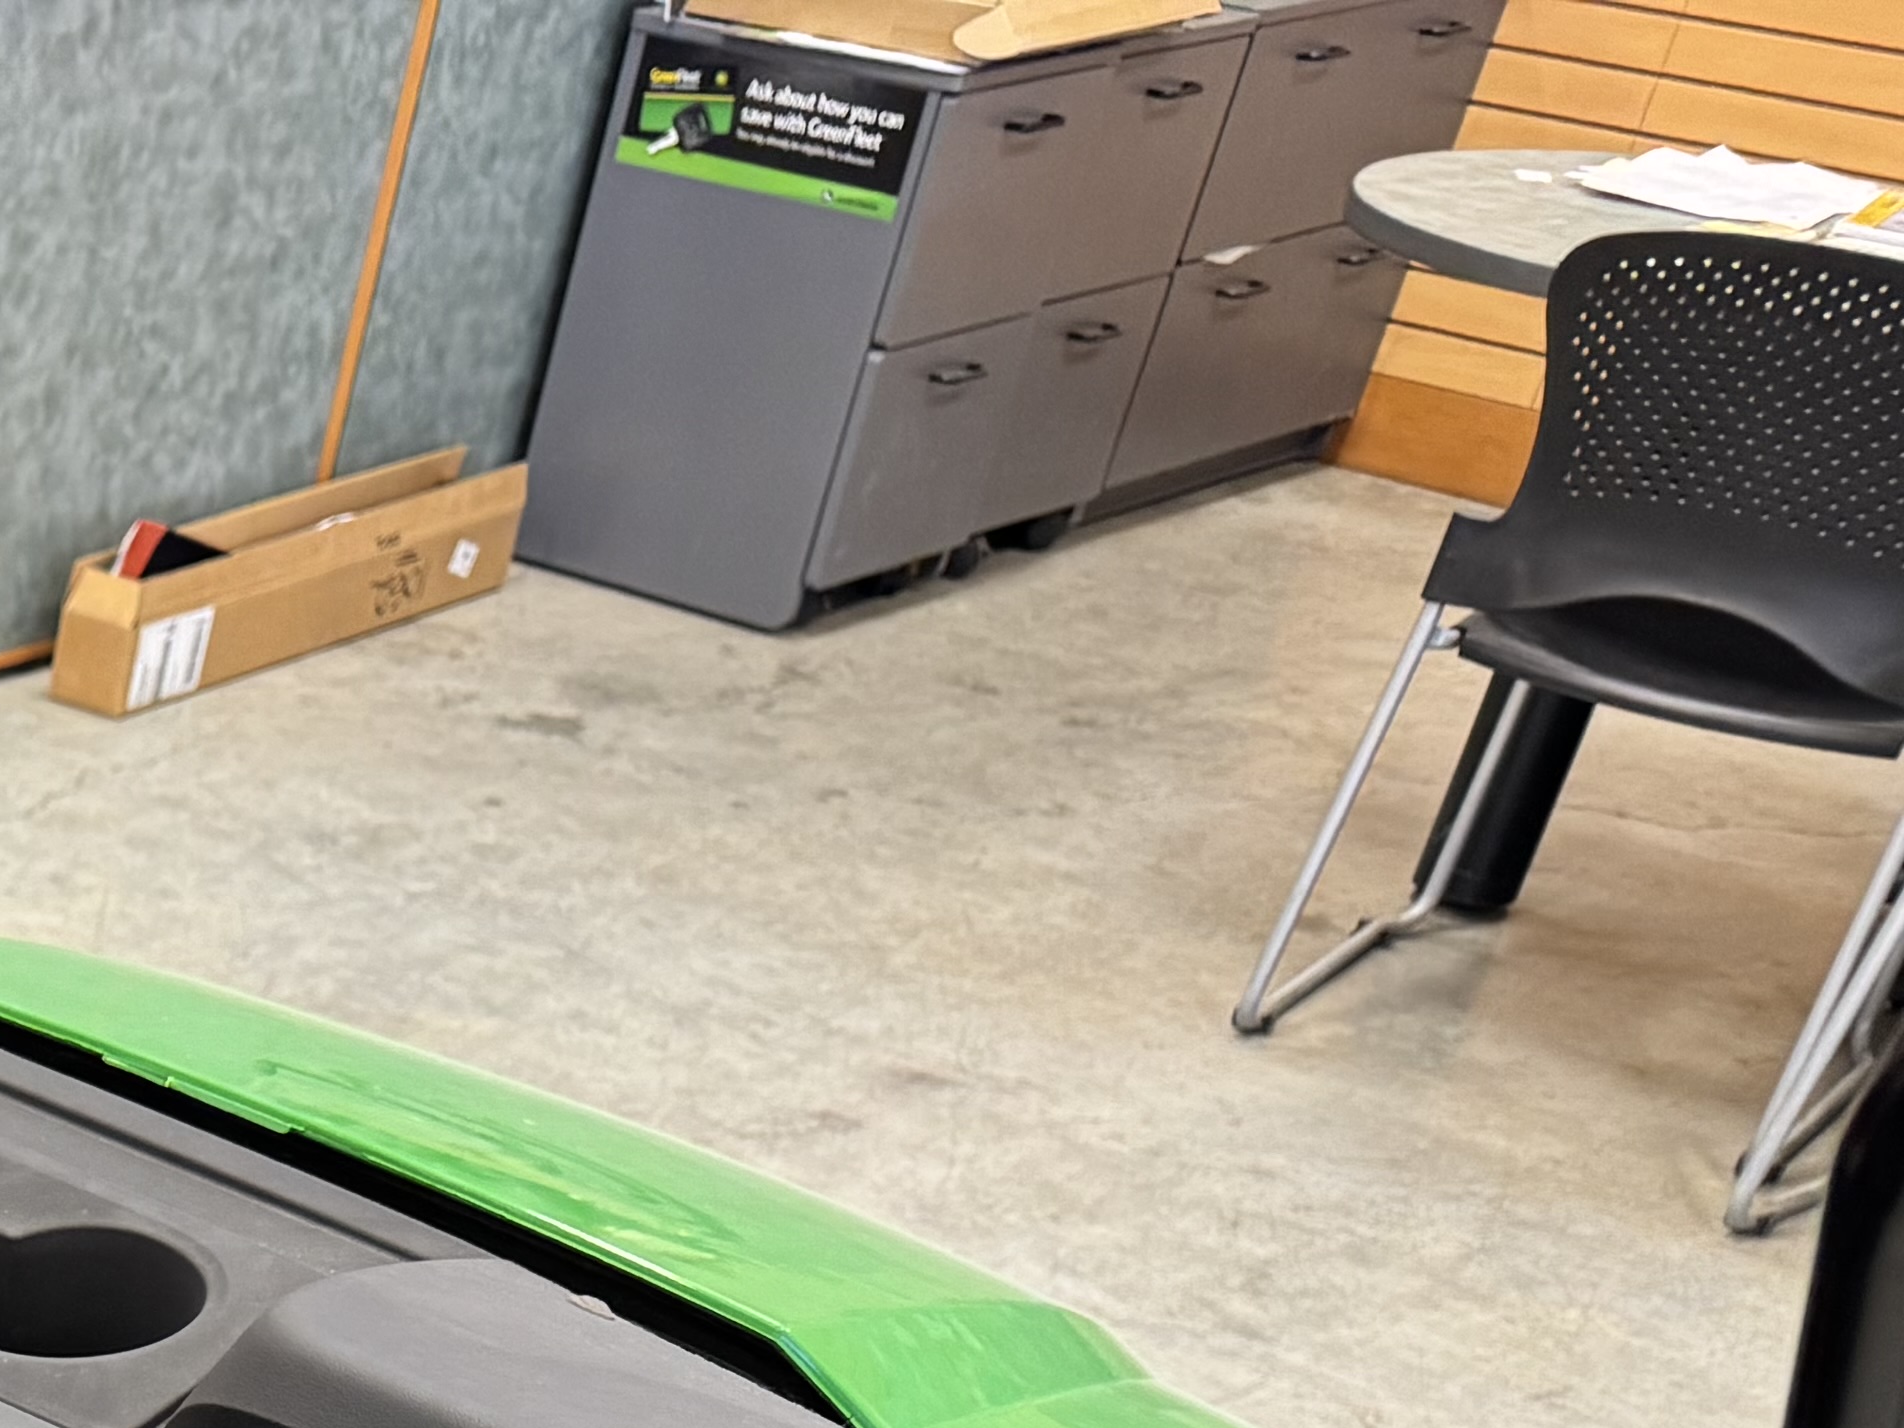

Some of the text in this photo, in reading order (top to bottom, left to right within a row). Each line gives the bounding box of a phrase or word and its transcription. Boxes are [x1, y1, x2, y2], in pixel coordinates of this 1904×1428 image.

[745, 79, 904, 129] Ask about how you can
[740, 107, 773, 127] save
[773, 112, 806, 134] with
[807, 117, 882, 150] GreenFleet
